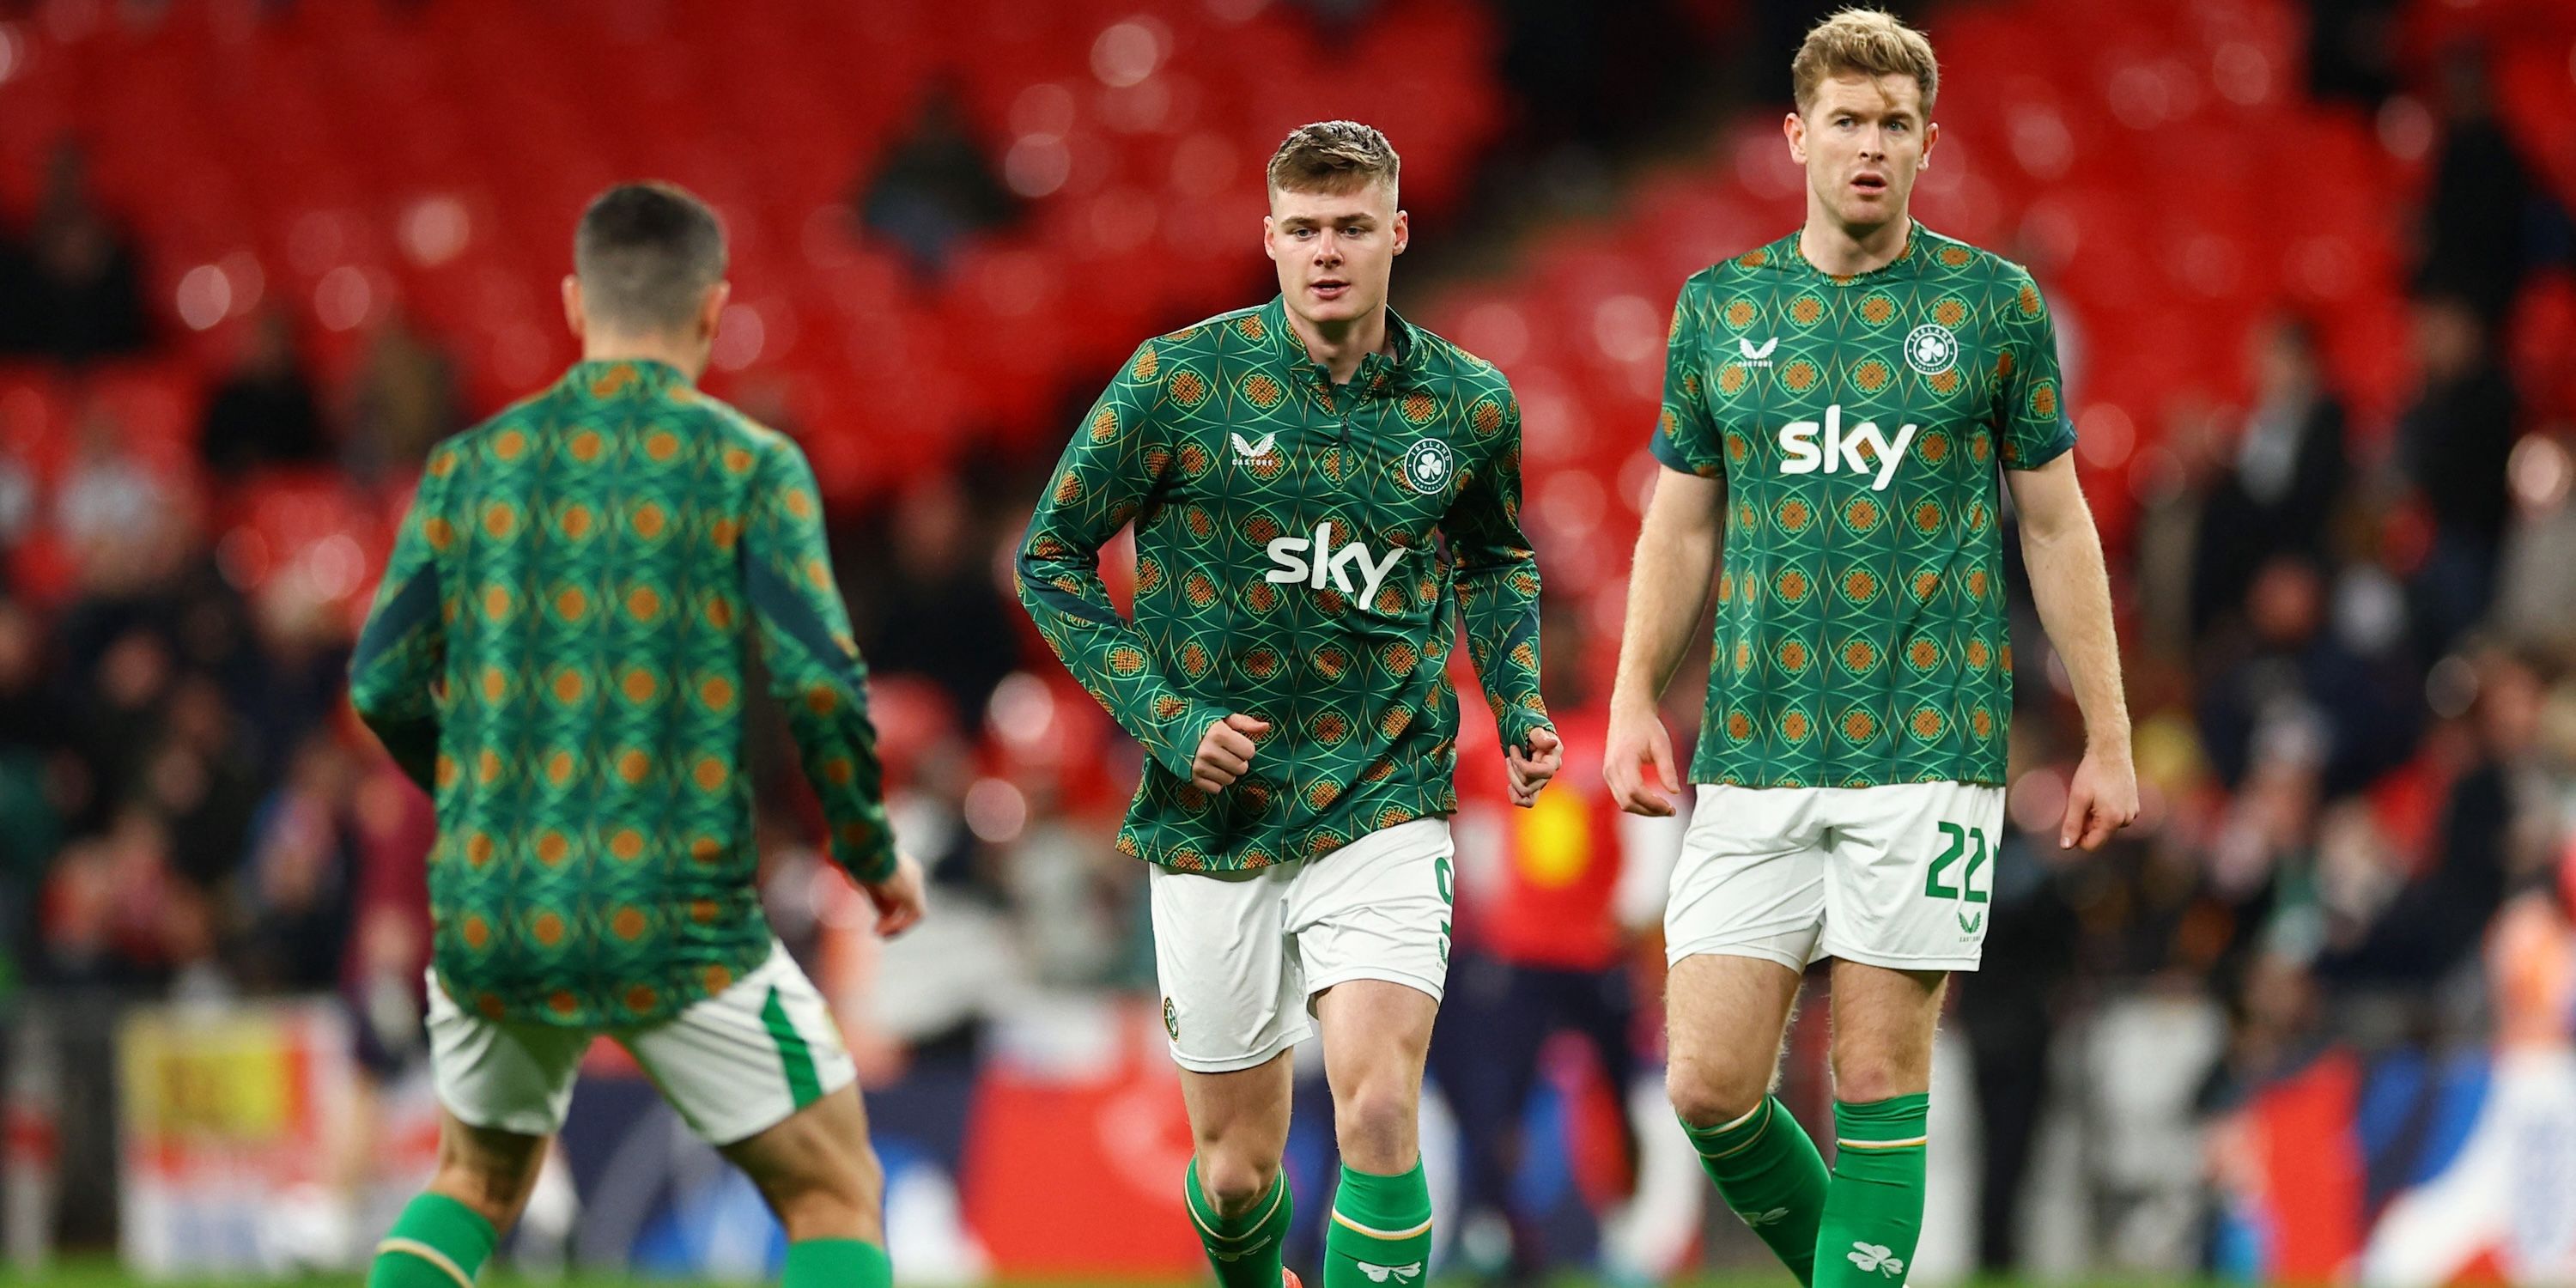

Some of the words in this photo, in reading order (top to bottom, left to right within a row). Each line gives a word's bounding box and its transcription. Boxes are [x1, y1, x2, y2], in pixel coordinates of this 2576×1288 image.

[1910, 327, 1953, 344] IRELAND
[1411, 440, 1451, 461] IRELAND
[1778, 404, 1917, 491] sky
[1265, 522, 1407, 611] sky
[1925, 821, 1988, 903] 22
